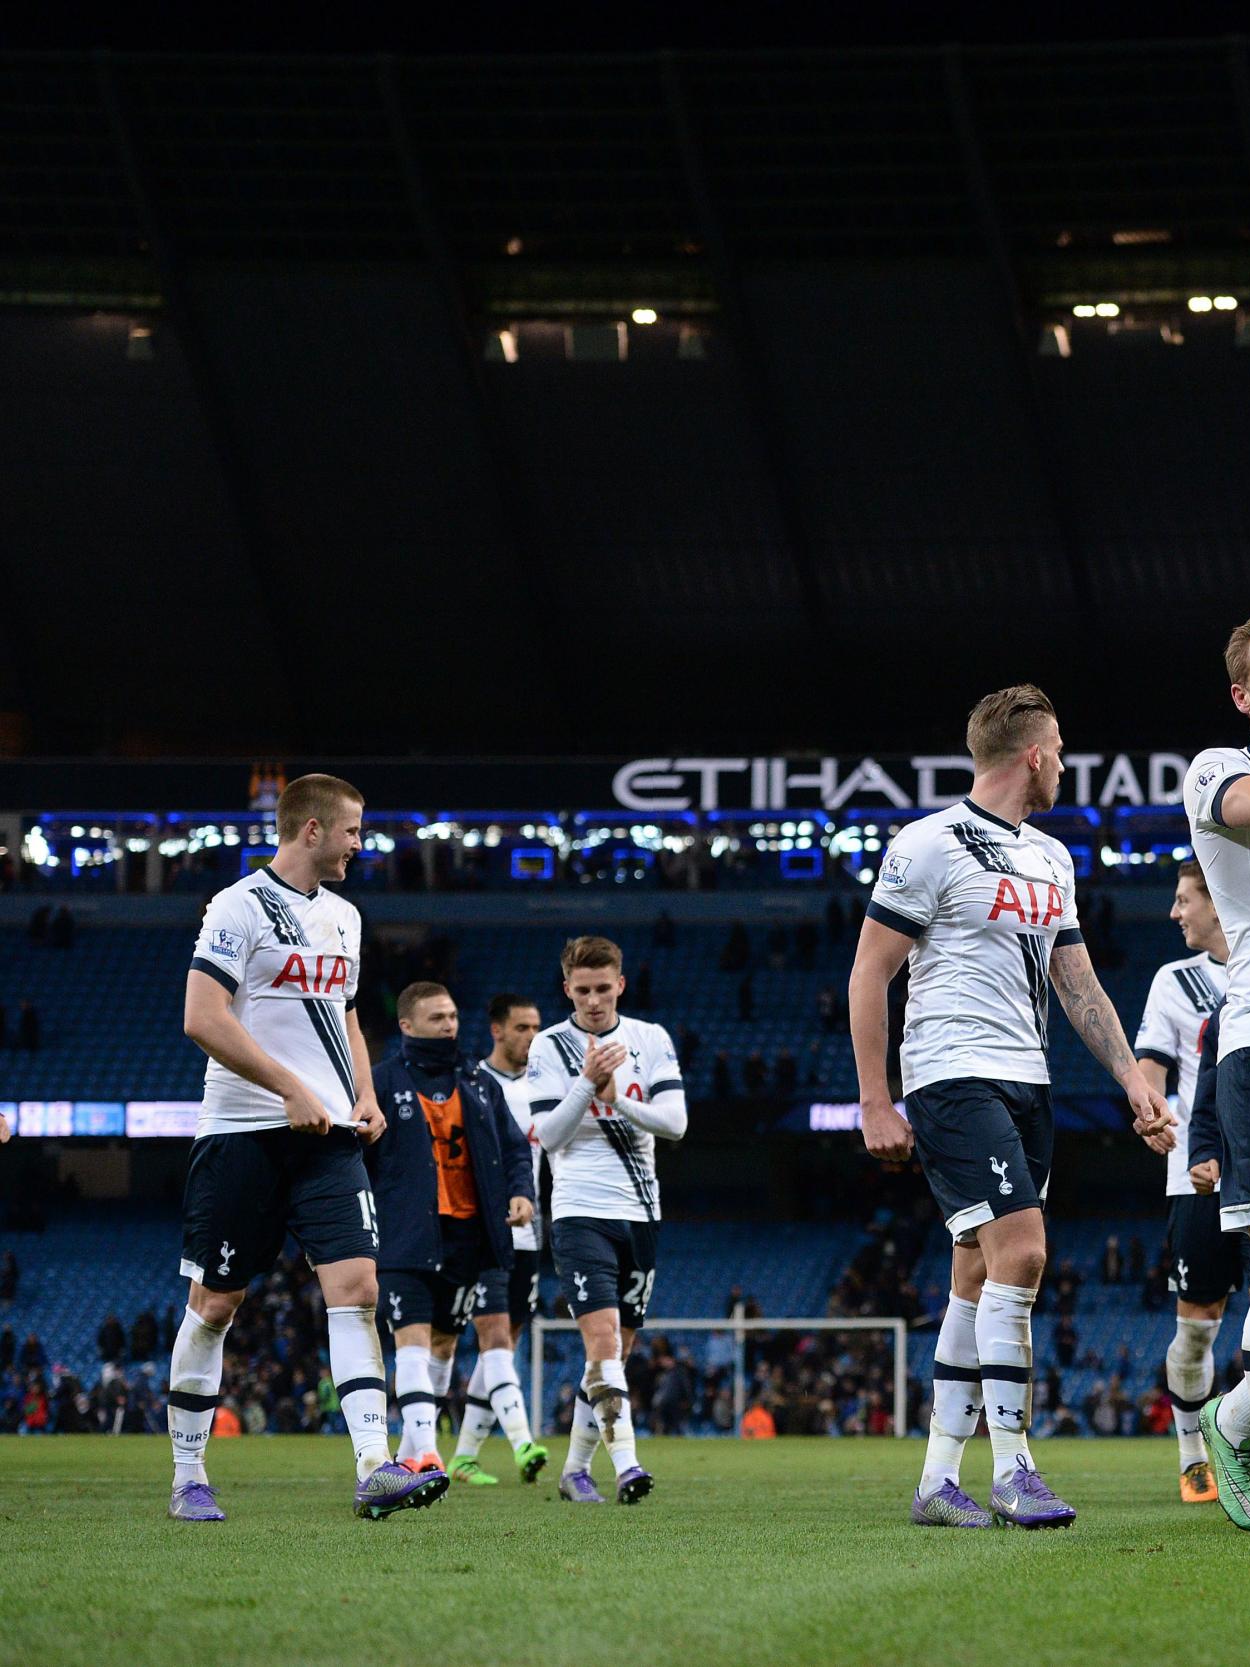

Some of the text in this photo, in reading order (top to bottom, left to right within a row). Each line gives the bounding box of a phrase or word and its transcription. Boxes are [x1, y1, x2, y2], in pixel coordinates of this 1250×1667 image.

[611, 753, 1190, 810] ETIHAD TAD
[987, 878, 1064, 927] AIA
[271, 952, 348, 994] AIA
[623, 1268, 656, 1305] 28
[171, 1429, 208, 1443] SPURS
